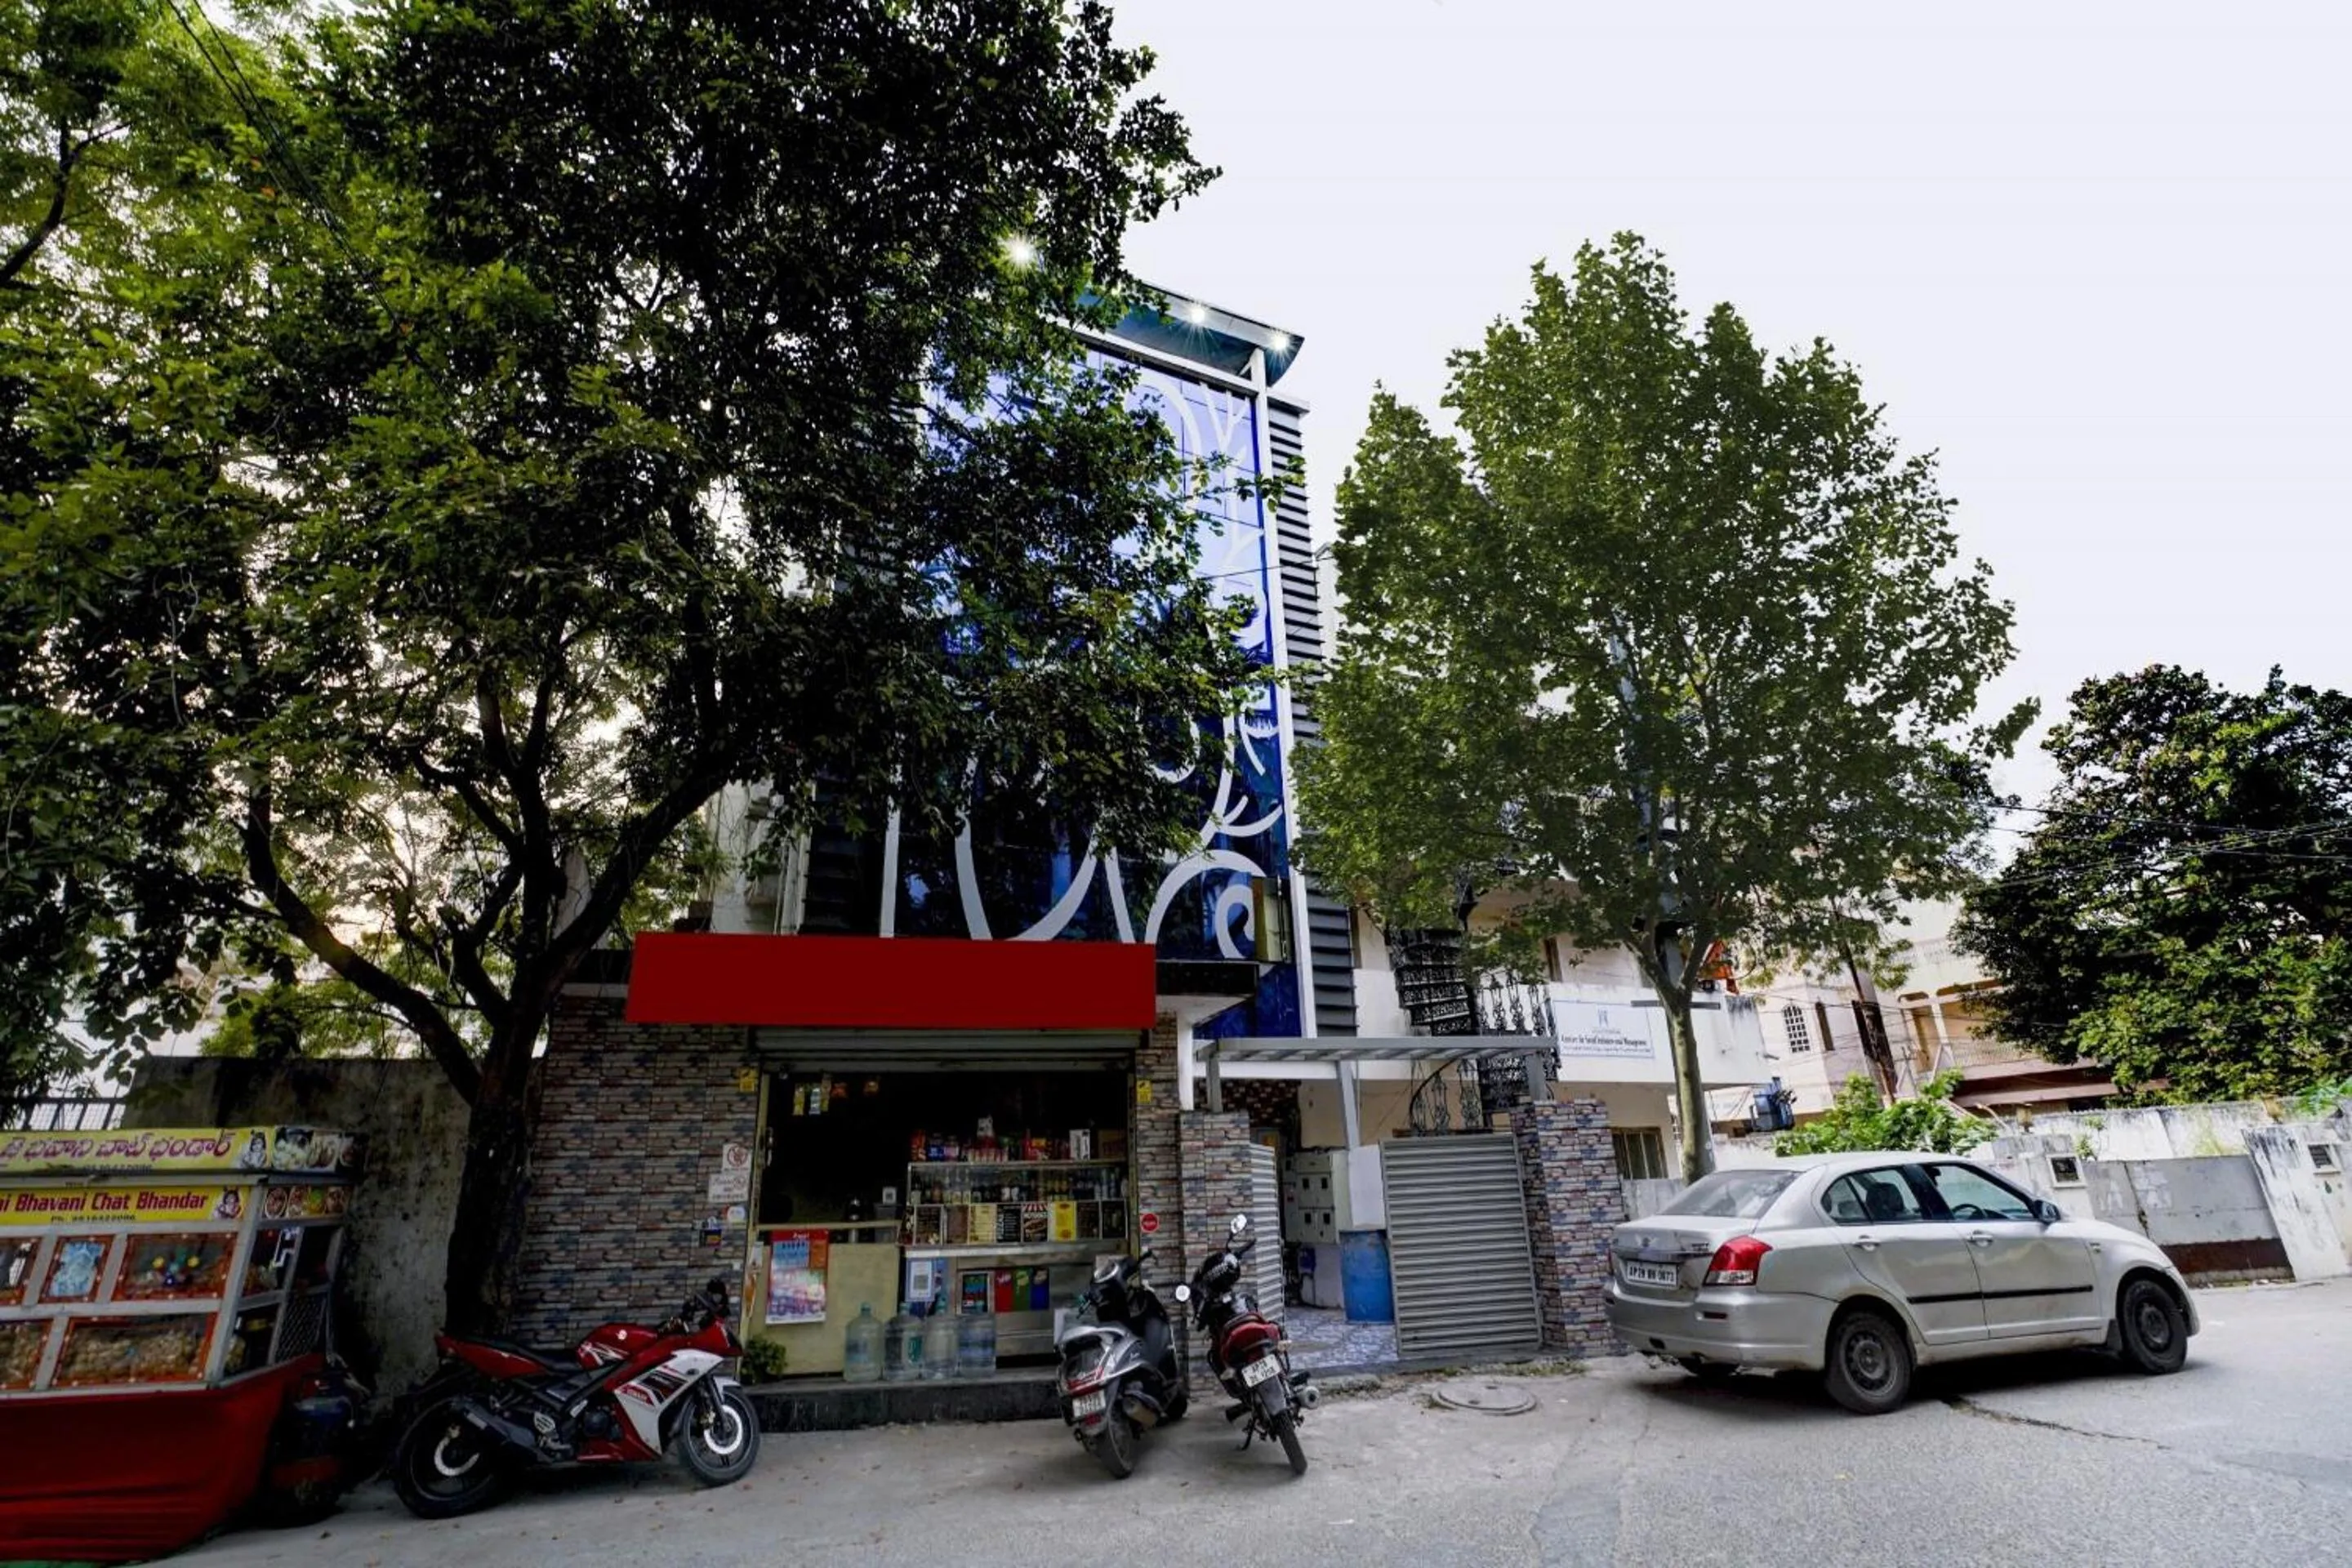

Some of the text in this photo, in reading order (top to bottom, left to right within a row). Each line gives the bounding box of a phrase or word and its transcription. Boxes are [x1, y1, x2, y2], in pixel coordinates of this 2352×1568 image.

[16, 1192, 87, 1212] Bhavani
[91, 1192, 131, 1211] Chat
[136, 1192, 208, 1210] Bhandar
